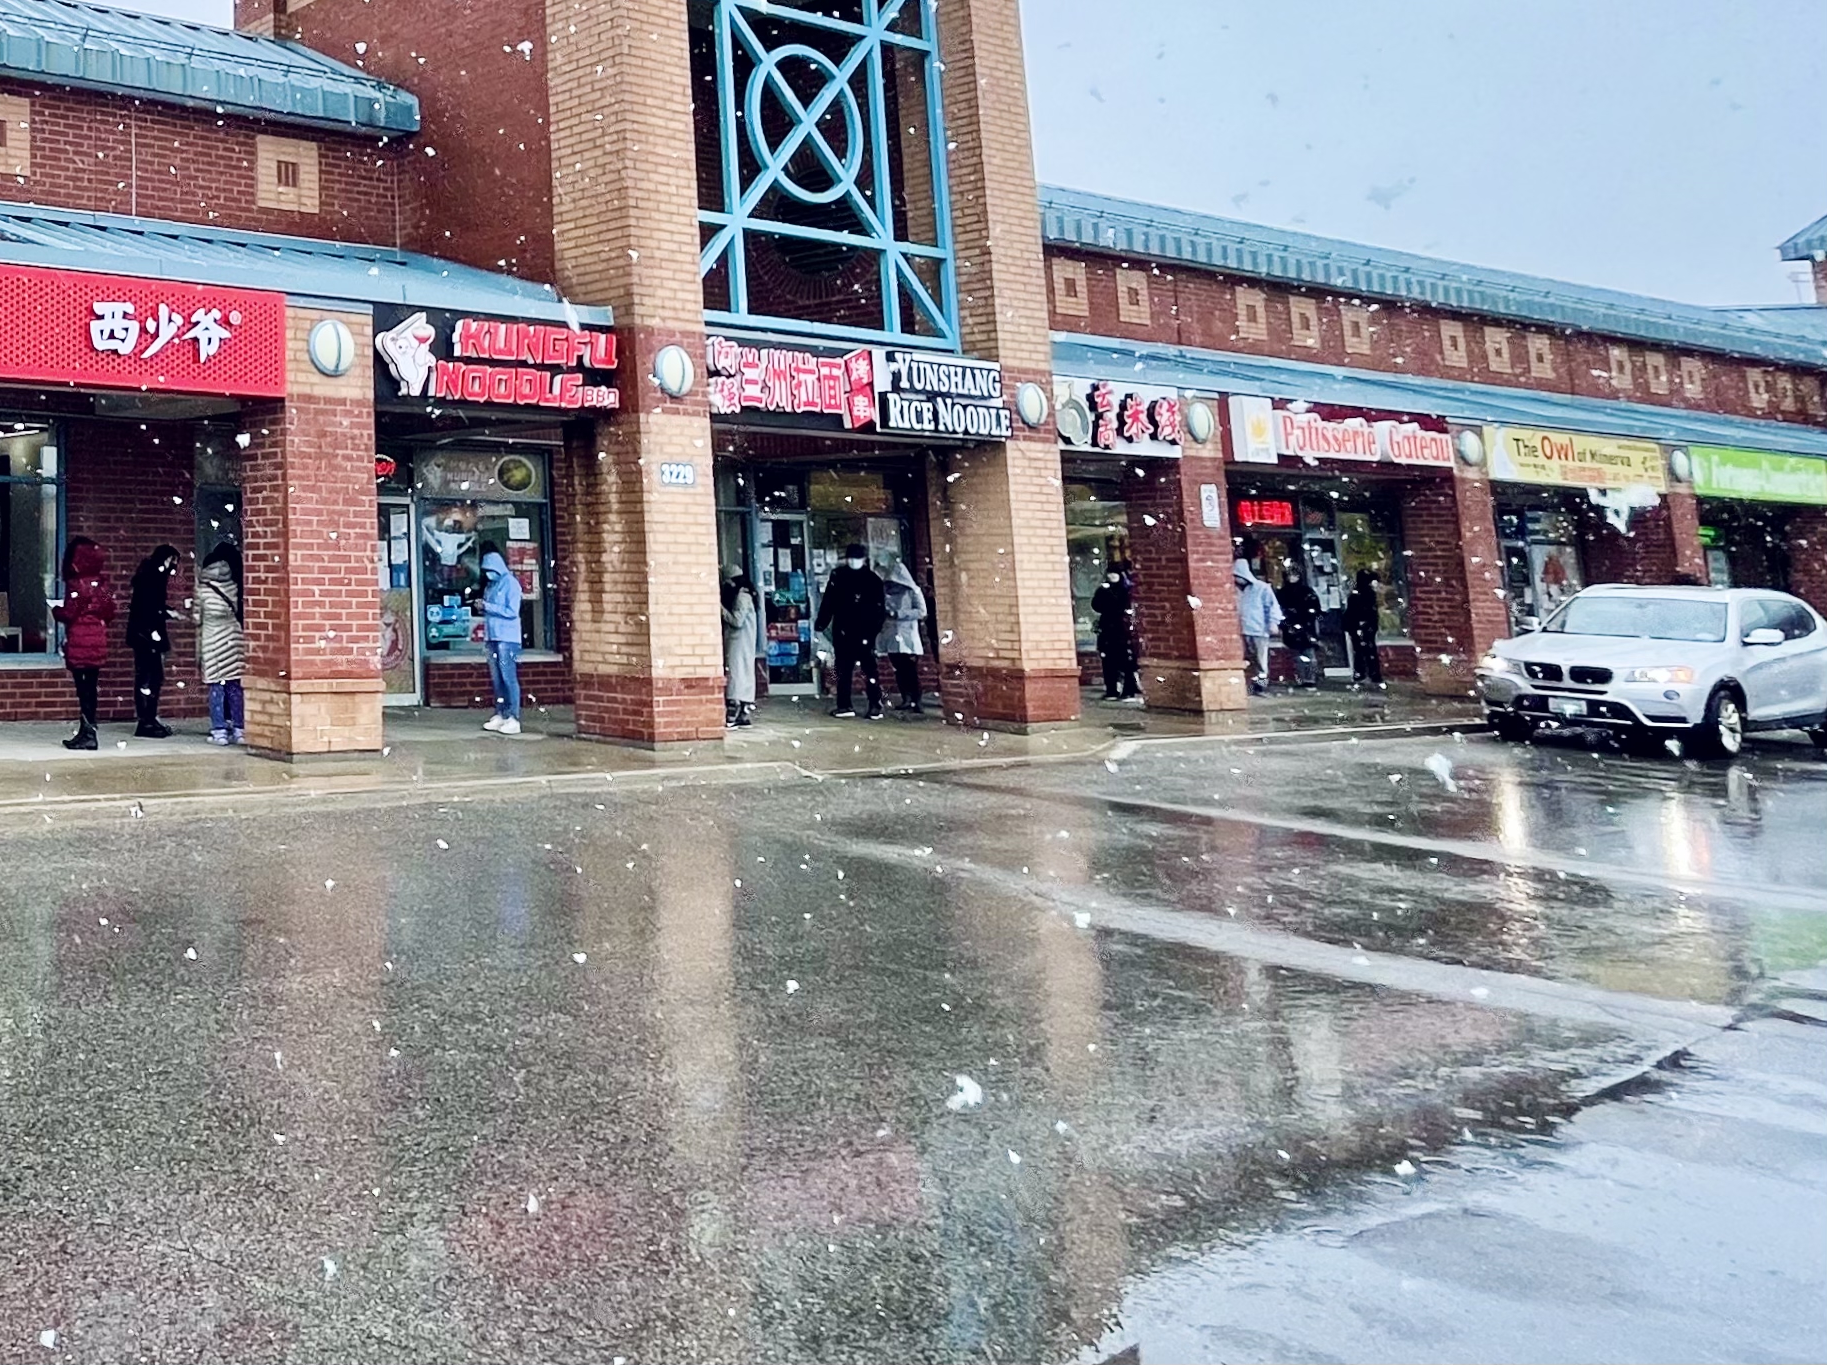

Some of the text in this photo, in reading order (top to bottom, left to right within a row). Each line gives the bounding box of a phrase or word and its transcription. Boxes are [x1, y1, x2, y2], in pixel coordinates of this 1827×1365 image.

[89, 300, 233, 365] 西少爷
[456, 318, 619, 370] KUNGFU
[435, 360, 620, 409] NOODLE BBQ
[739, 347, 846, 414] 兰州拉面
[849, 355, 873, 420] 烤串
[1281, 414, 1452, 463] Patisserie Gateau
[1512, 437, 1540, 459] The
[1540, 435, 1576, 463] Owl
[660, 463, 694, 485] 3229
